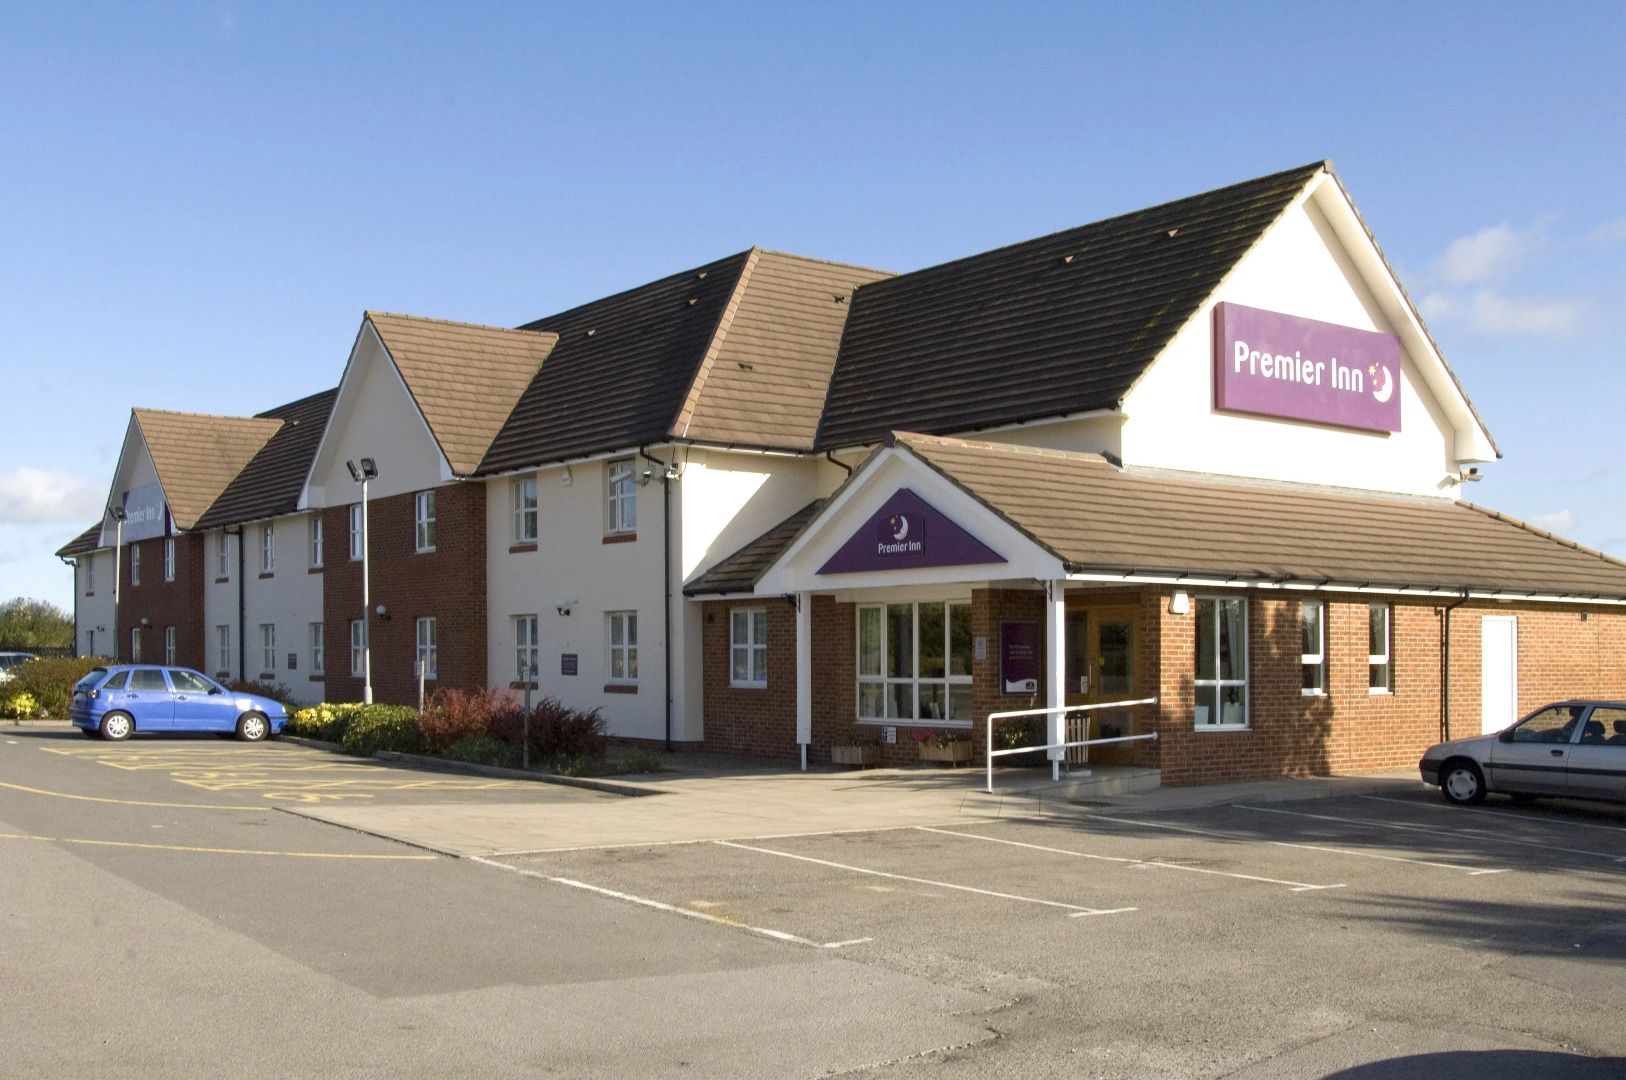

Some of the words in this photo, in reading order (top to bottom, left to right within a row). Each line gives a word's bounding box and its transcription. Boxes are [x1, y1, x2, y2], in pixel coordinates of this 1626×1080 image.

[1234, 340, 1326, 386] Premier
[1331, 358, 1364, 393] Inn
[878, 541, 908, 554] Premier
[909, 540, 921, 552] Inn
